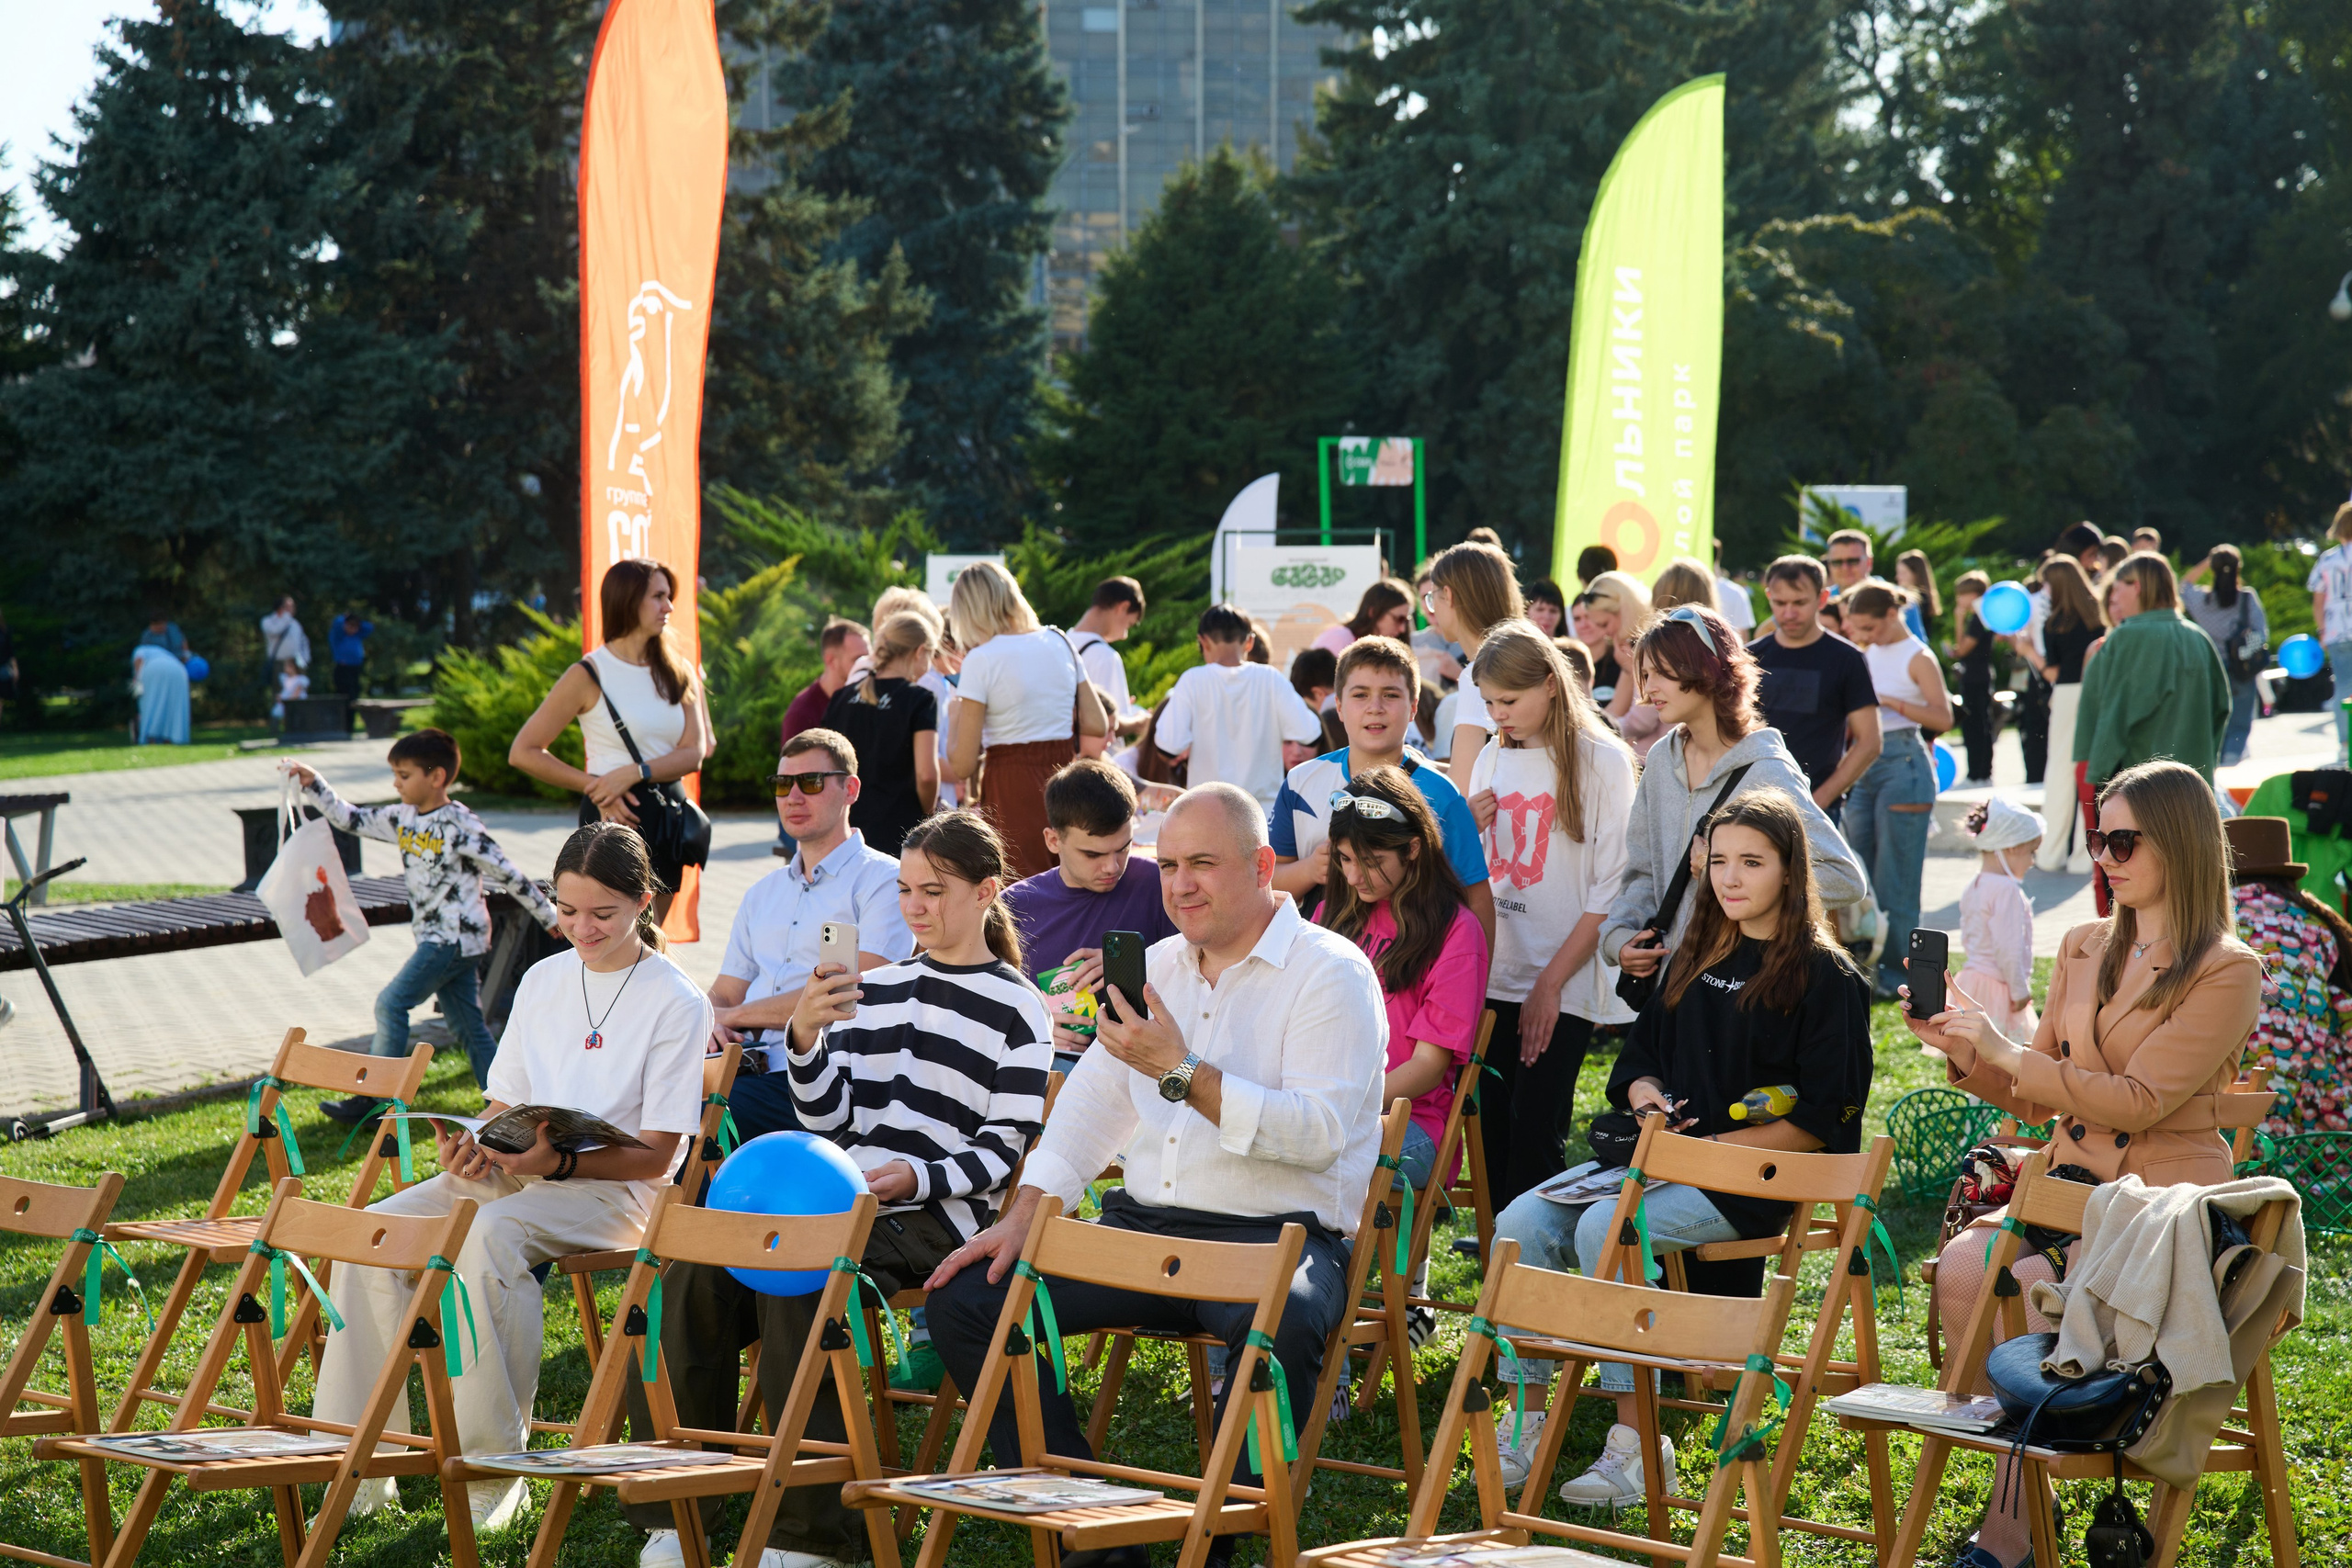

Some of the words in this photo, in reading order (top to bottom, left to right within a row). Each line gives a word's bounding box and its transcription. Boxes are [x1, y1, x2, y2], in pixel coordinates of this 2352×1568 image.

[1674, 362, 1697, 457] парк
[1497, 911, 1510, 919] 2020
[1702, 972, 1727, 988] STONE
[81, 1232, 96, 1240] СБЕР
[255, 1244, 271, 1254] СБЕР
[2046, 1247, 2064, 1267] Nikon
[1278, 1388, 1286, 1406] СБЕР
